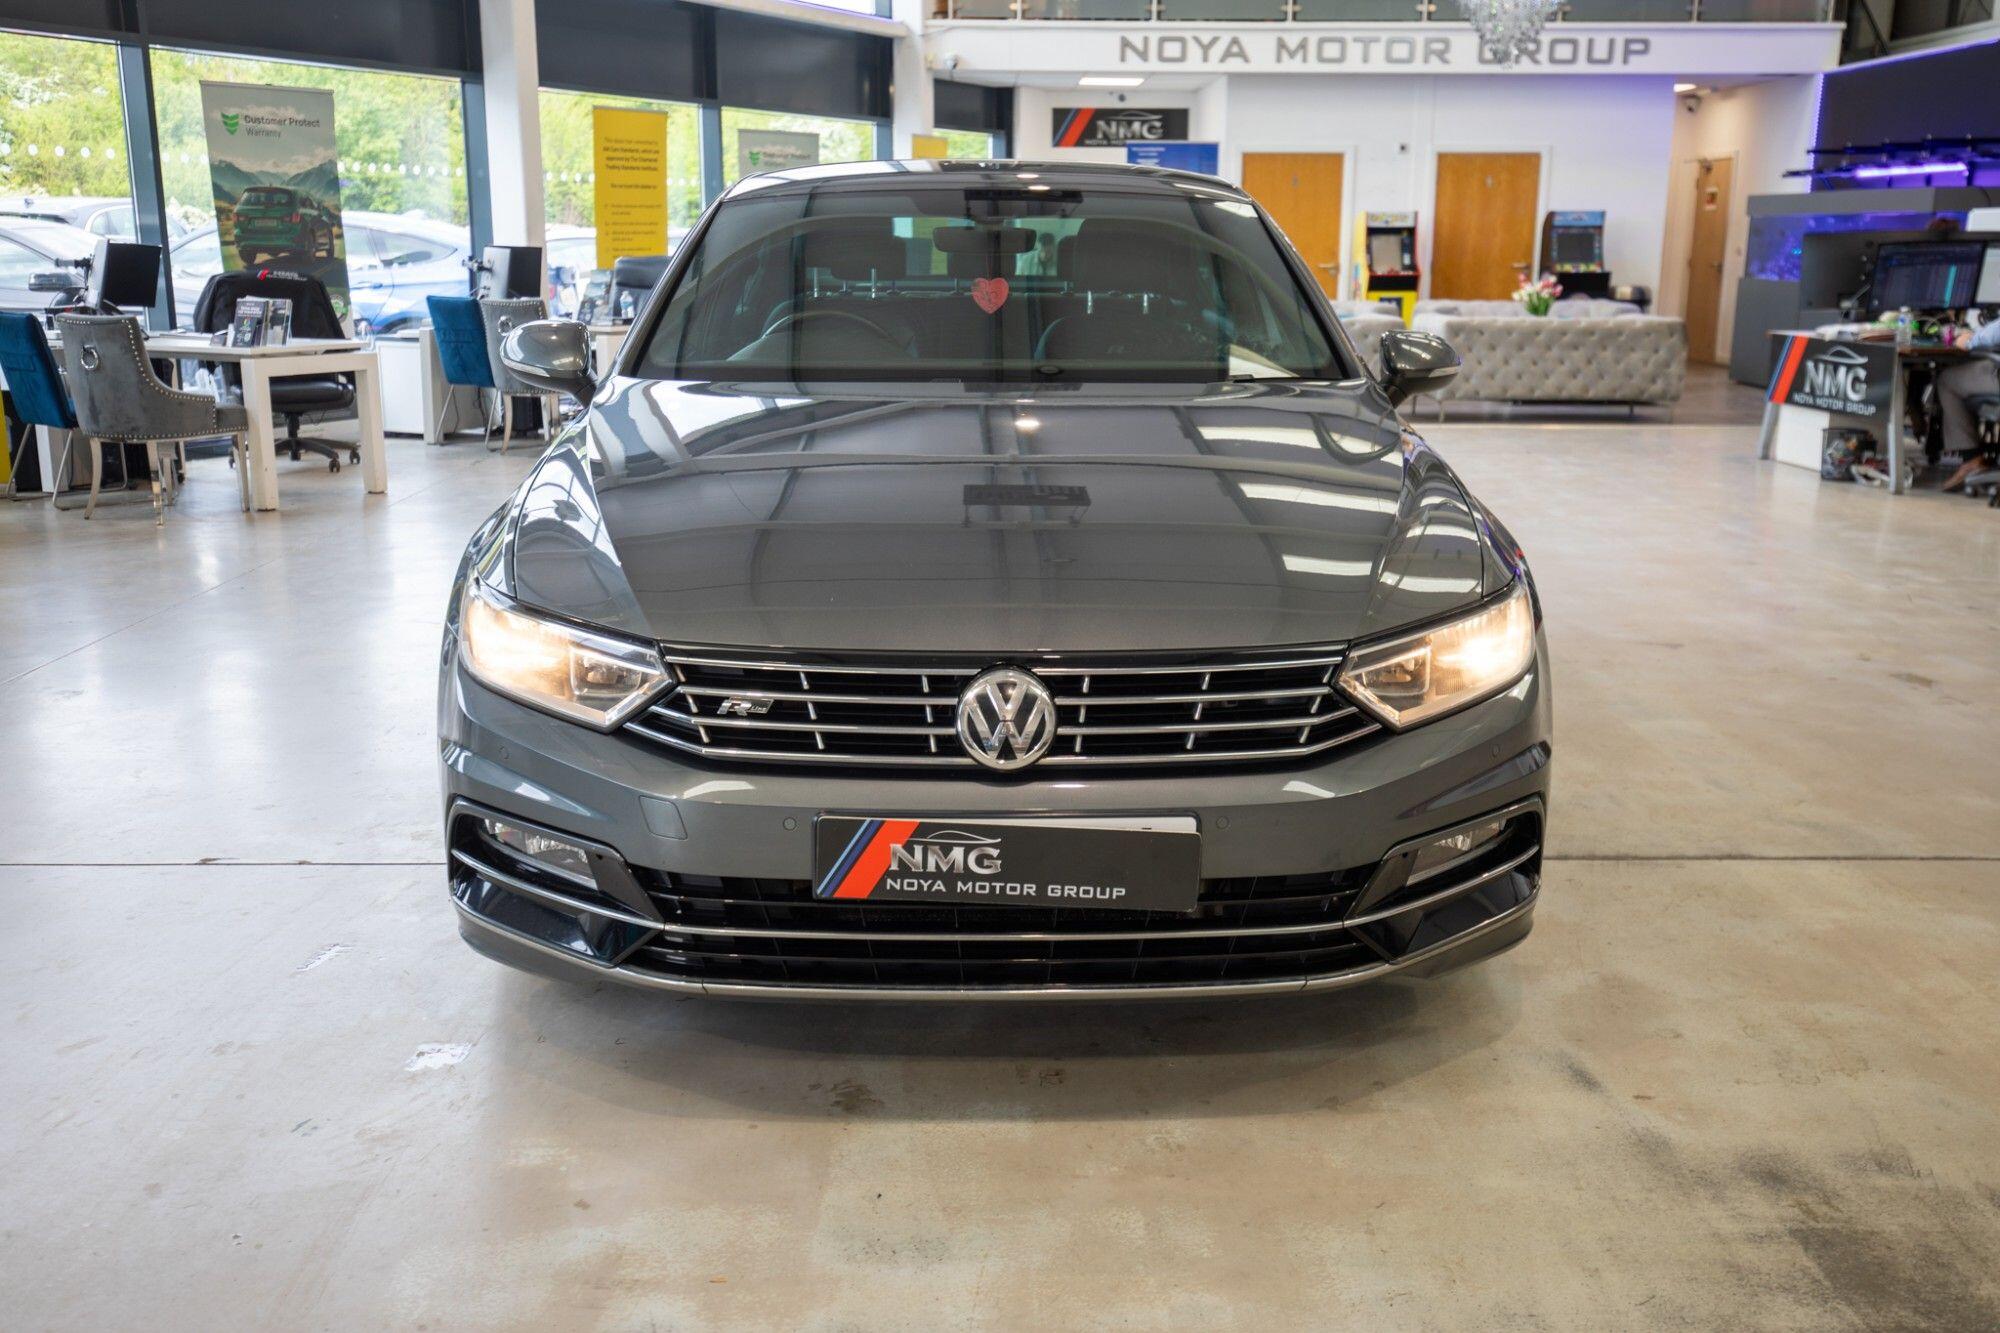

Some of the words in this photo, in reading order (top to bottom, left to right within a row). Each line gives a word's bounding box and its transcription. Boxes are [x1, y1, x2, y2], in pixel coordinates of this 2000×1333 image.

[1119, 35, 1251, 64] NOYA
[1275, 36, 1451, 65] MOTOR
[244, 115, 287, 126] Customer
[288, 117, 321, 128] Protect
[246, 127, 281, 139] Warranty
[1096, 120, 1164, 139] NMG
[1803, 359, 1868, 402] NMG
[1792, 392, 1814, 405] NOYA
[1816, 397, 1845, 411] MOTOR
[1845, 401, 1876, 416] GROUP
[889, 843, 1002, 875] NMG
[886, 878, 947, 893] NOYA
[956, 881, 1037, 897] MOTOR
[1047, 884, 1127, 900] GROUP
